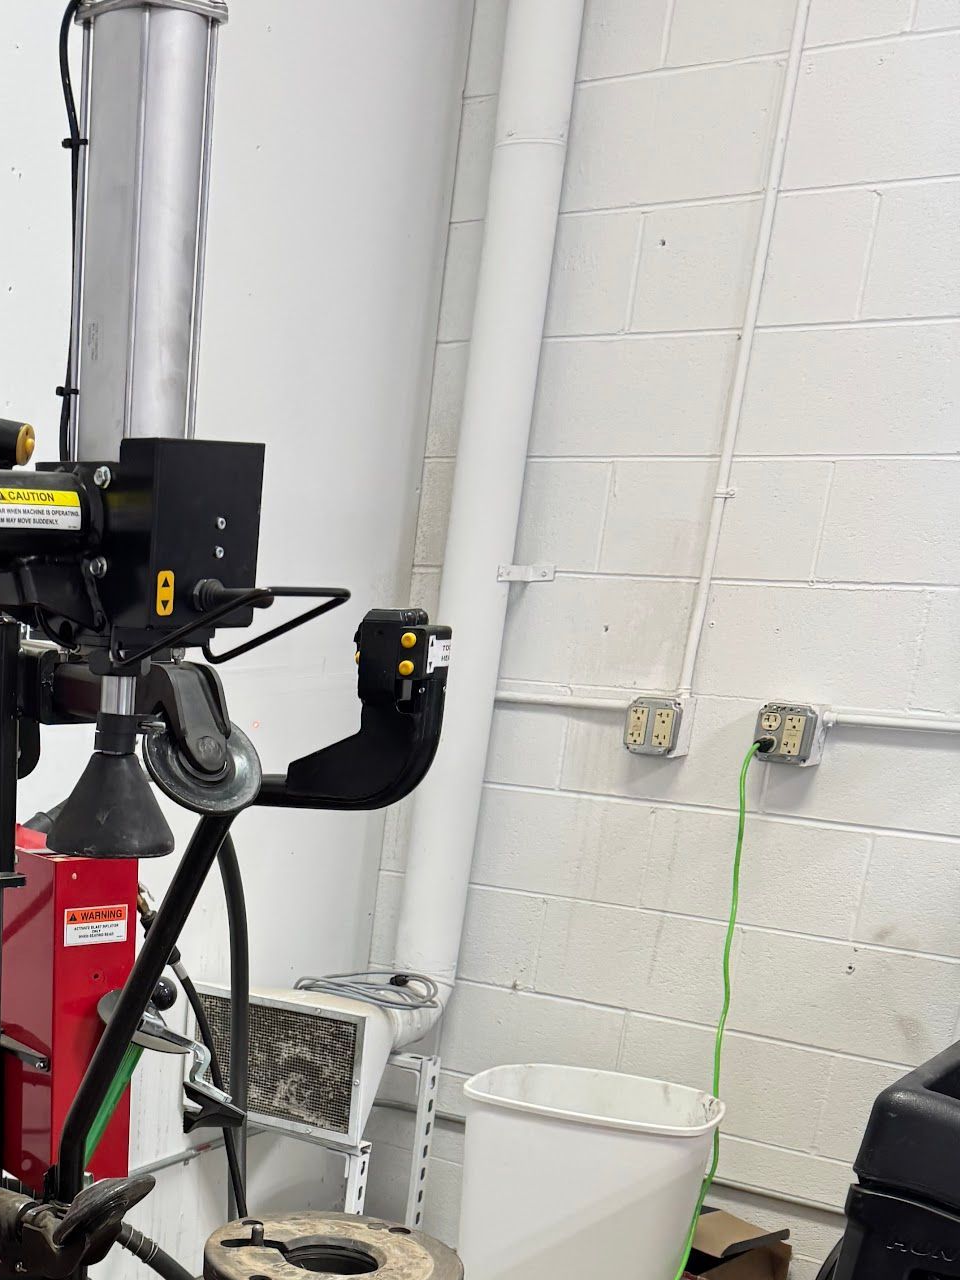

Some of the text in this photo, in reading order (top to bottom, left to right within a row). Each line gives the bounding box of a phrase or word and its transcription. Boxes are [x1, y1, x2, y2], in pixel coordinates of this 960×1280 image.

[8, 491, 55, 502] CAUTION
[22, 508, 45, 516] MACHINE
[32, 518, 59, 526] SUDDENLY.
[80, 909, 123, 921] WARNING
